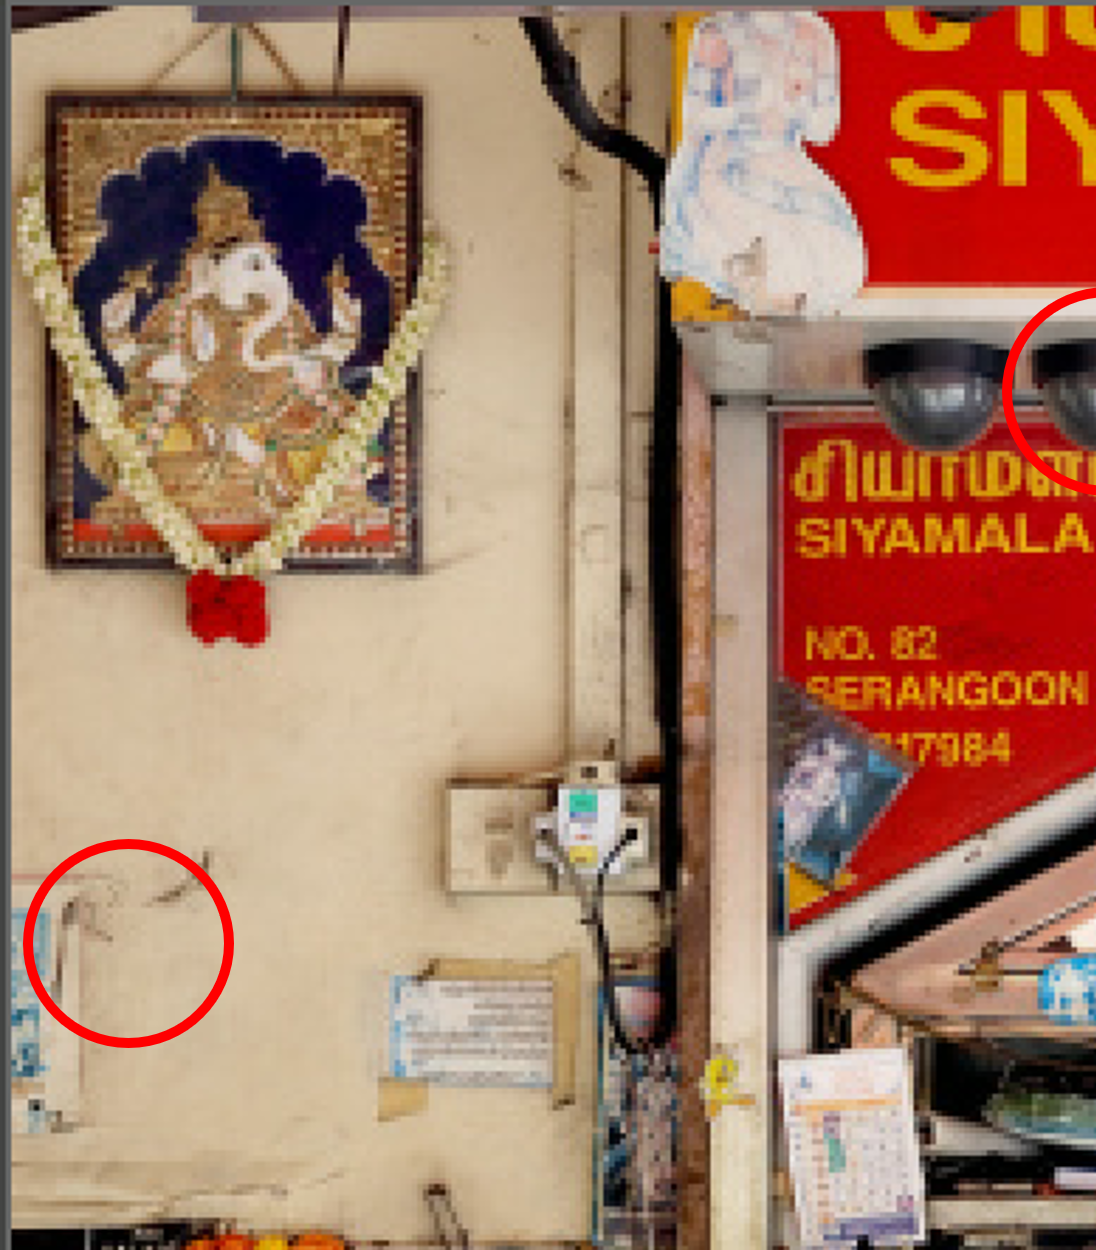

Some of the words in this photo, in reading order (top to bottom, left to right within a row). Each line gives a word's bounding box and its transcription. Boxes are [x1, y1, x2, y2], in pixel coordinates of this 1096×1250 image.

[795, 511, 1095, 557] SIYAMALA
[804, 624, 875, 661] NO.
[890, 624, 938, 661] 82
[804, 669, 1090, 711] SERANGOON
